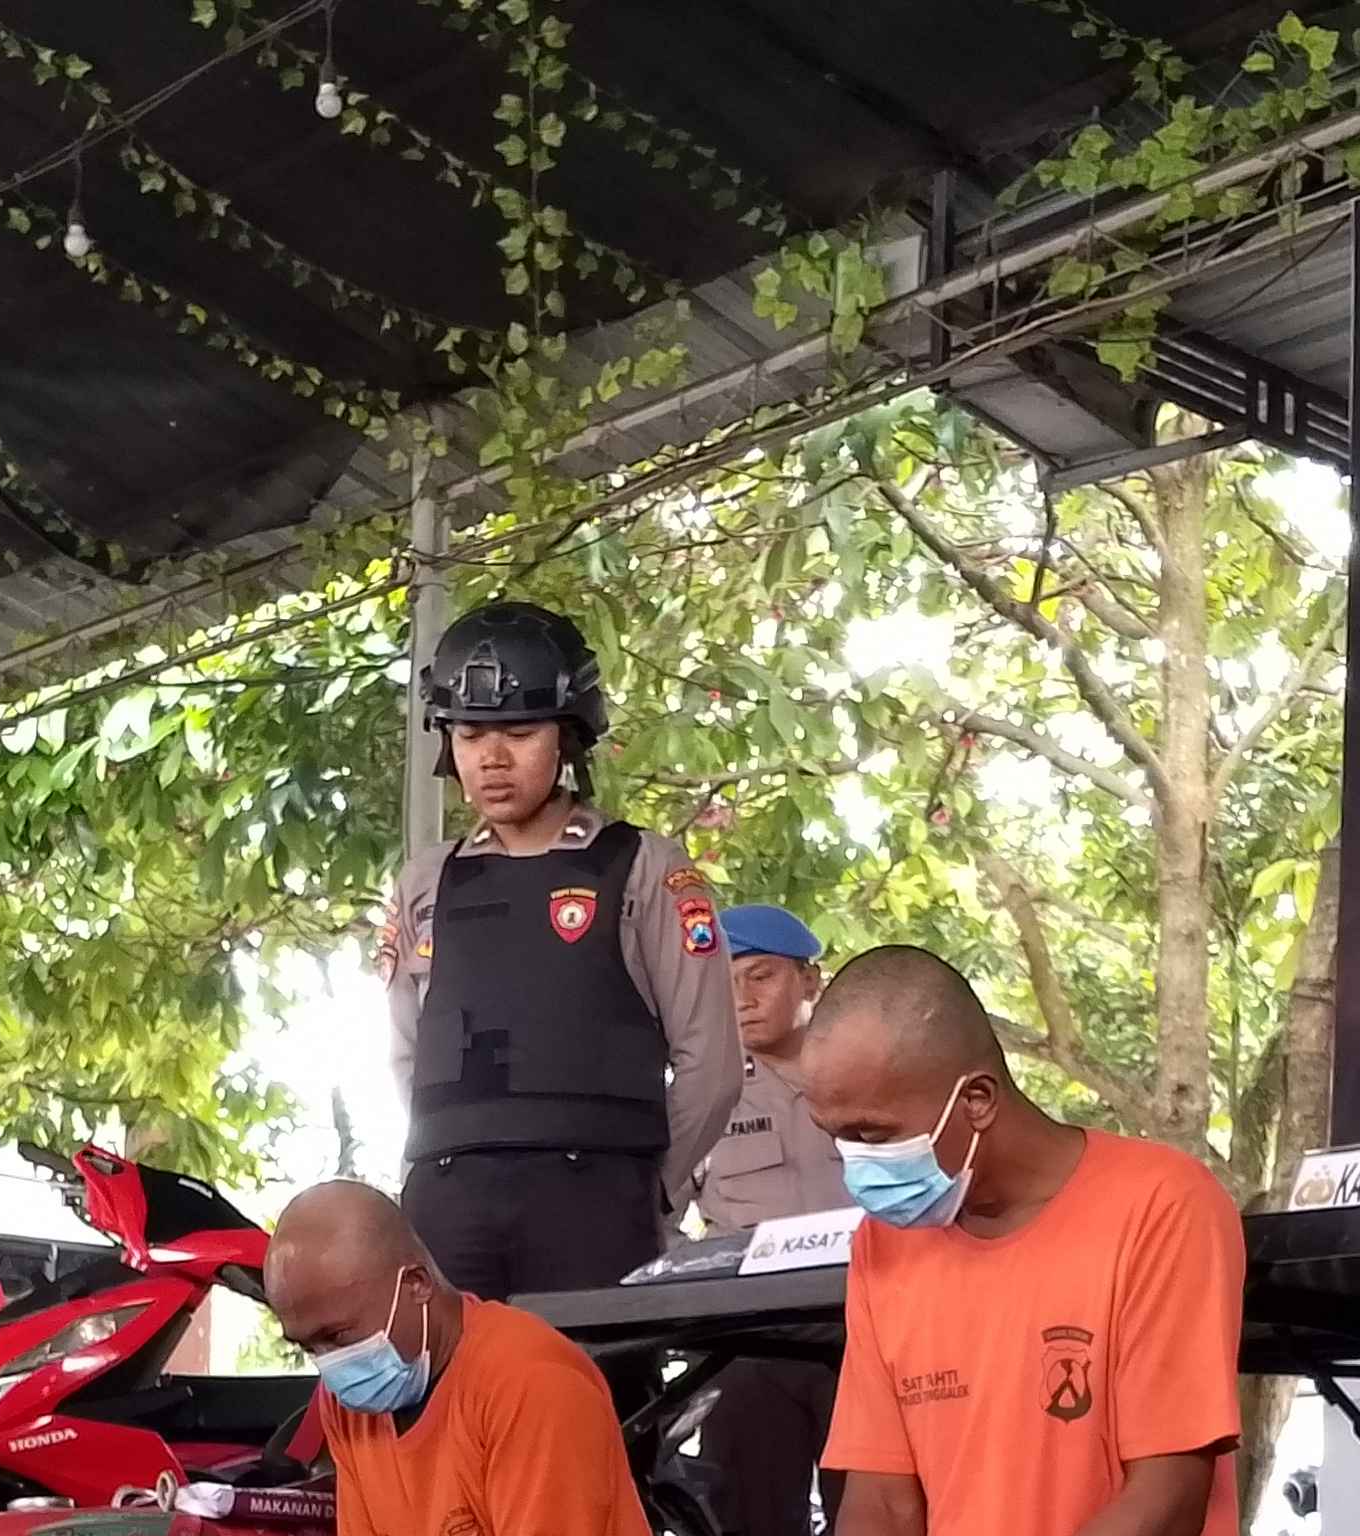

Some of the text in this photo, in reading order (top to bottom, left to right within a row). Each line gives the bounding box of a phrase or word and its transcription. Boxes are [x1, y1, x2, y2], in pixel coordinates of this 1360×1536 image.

[781, 1231, 844, 1254] KASAT
[8, 1428, 78, 1452] HONDA
[250, 1497, 337, 1518] MAKANAN D
